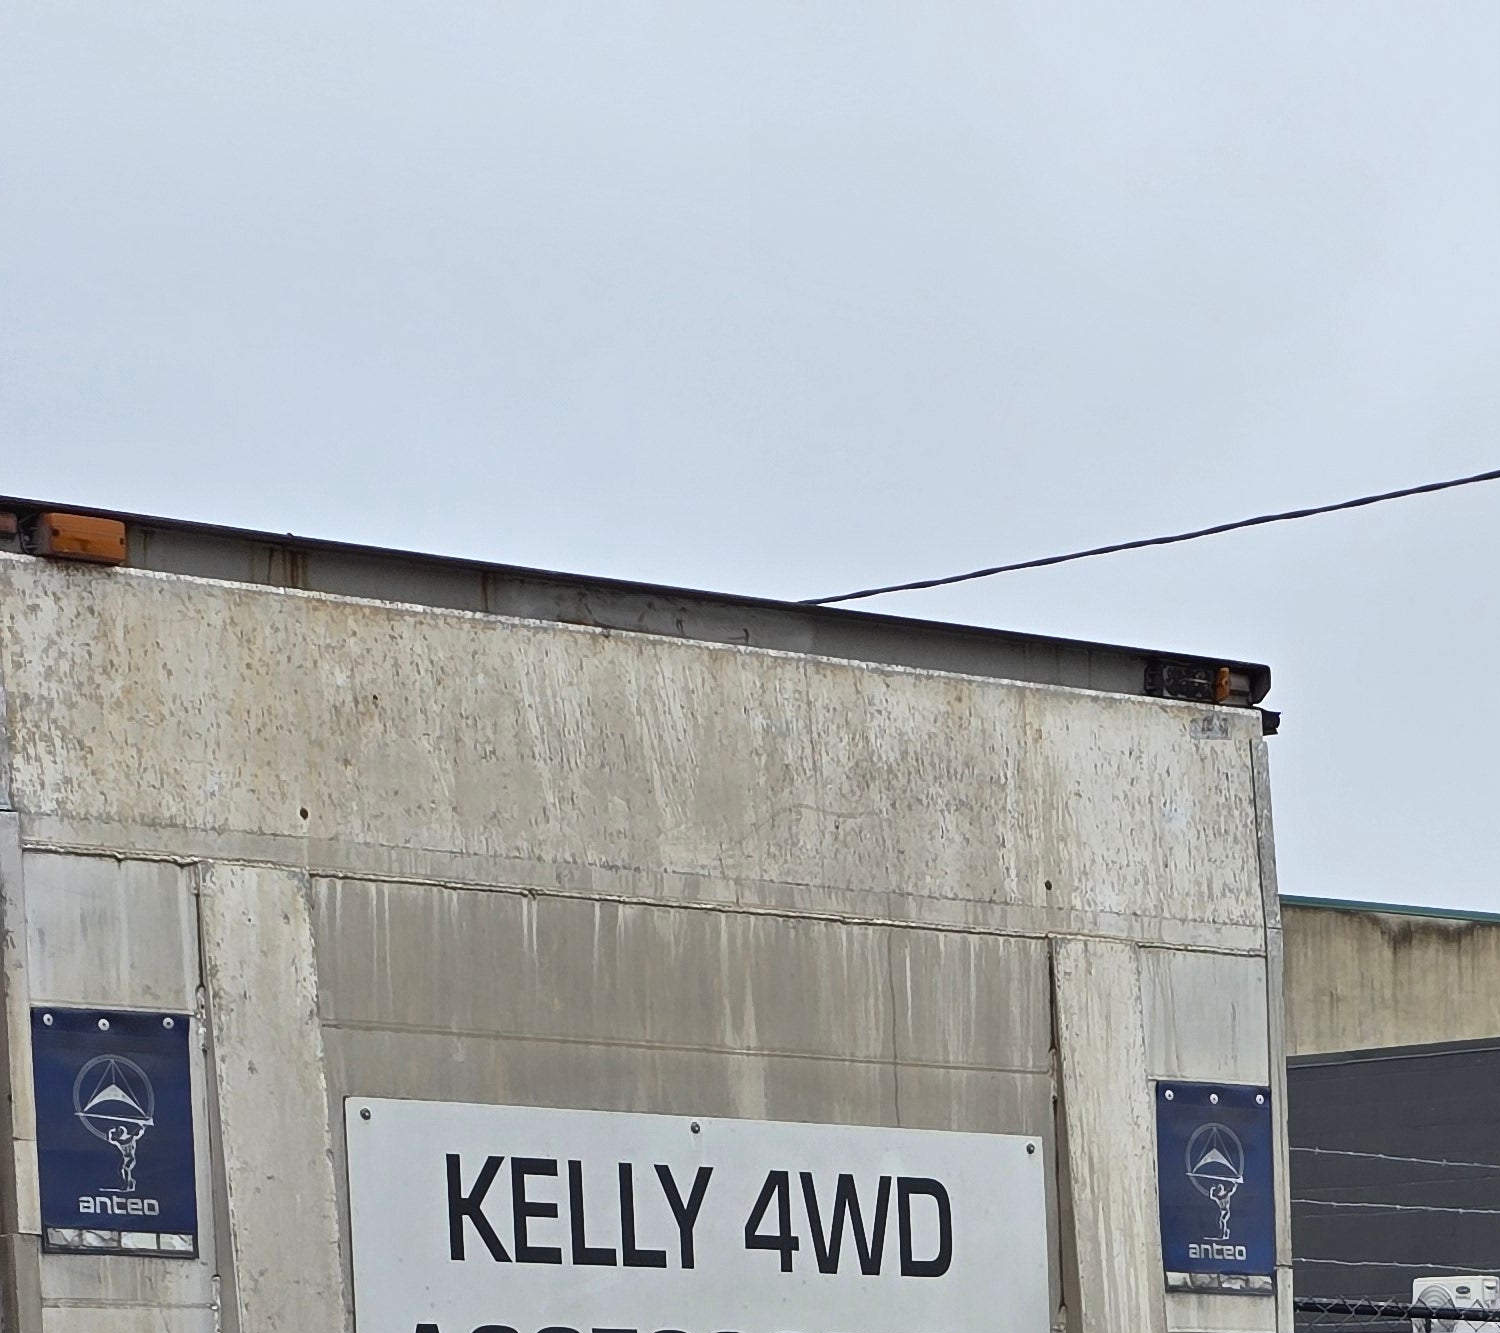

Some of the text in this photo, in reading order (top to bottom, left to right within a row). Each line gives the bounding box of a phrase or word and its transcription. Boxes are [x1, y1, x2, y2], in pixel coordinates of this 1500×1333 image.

[78, 1195, 160, 1217] anteo
[444, 1153, 953, 1279] KELLY 4WD
[1188, 1242, 1247, 1261] anteo
